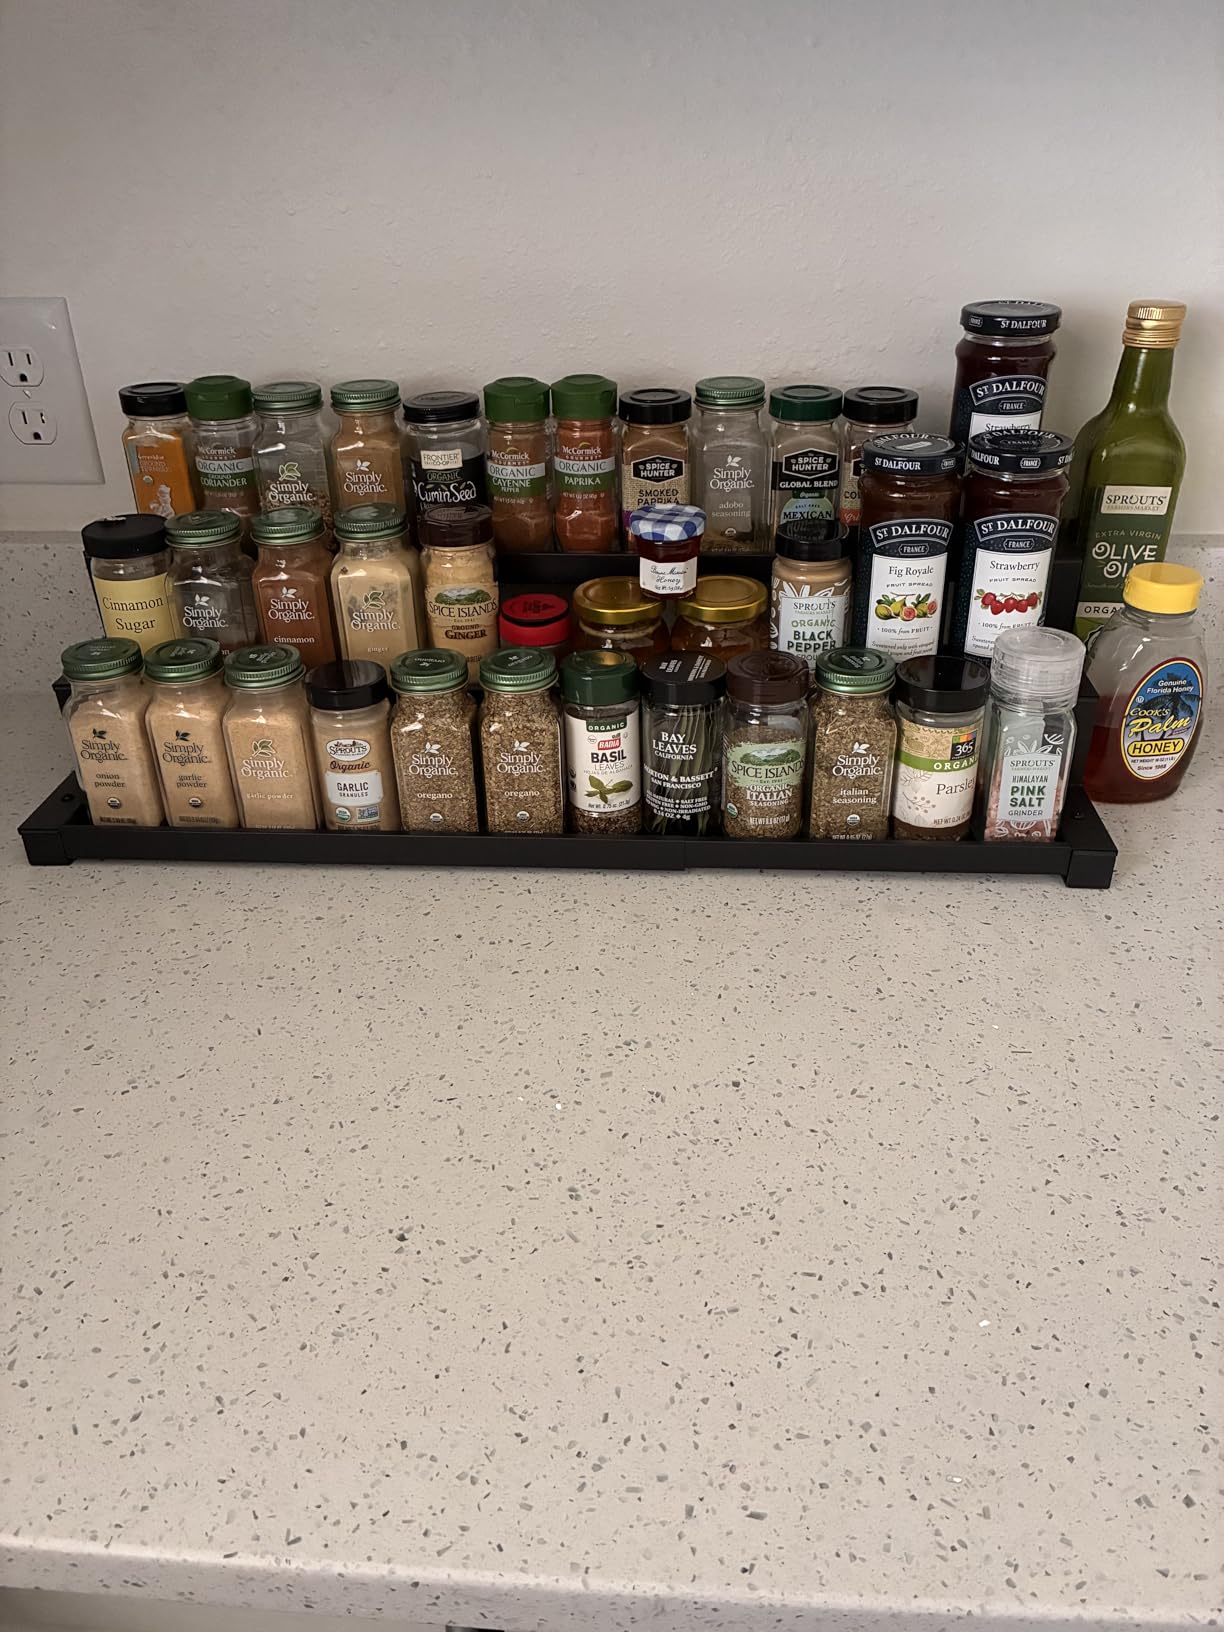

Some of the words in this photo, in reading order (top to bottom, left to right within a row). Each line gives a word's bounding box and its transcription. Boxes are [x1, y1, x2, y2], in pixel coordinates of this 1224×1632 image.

[1011, 320, 1047, 328] DALFOUR
[976, 386, 988, 397] ST
[992, 381, 1045, 395] DALFOUR
[492, 450, 530, 459] McCormick
[562, 445, 602, 454] McCormick
[798, 456, 824, 464] SPICE
[883, 460, 921, 470] DALFOUR
[198, 461, 244, 472] ORGANIC
[490, 465, 536, 477] ORGANIC
[559, 461, 606, 471] ORGANIC
[346, 472, 382, 485] Simply
[427, 471, 461, 480] ORGANIC
[713, 468, 751, 481] Simply
[200, 477, 247, 487] CORIANDER
[493, 478, 531, 487] CAYENNE
[565, 476, 601, 486] PAPRIKA
[270, 481, 309, 497] Simply
[418, 483, 452, 502] Cumin
[452, 481, 476, 501] Seed
[639, 489, 679, 497] SMOKED
[1106, 495, 1164, 505] SPROUTS
[711, 510, 750, 518] seasoning
[783, 511, 832, 519] MEXICAN
[890, 525, 949, 538] DALFOUR
[996, 520, 1054, 533] DALFOUR
[1096, 530, 1125, 538] EXTRA
[1130, 530, 1161, 540] VIRGIN
[1092, 542, 1158, 560] OLIVE
[889, 566, 902, 575] Fig
[905, 566, 934, 576] Royale
[990, 561, 1040, 571] Strawberry
[656, 576, 681, 585] Honey
[103, 597, 163, 611] Cinnamon
[270, 599, 309, 611] Simply
[429, 602, 455, 617] SPICE
[458, 599, 497, 617] ISLANDS
[794, 601, 835, 610] SPROUTS
[184, 606, 222, 619] Simply
[352, 610, 394, 624] Simply
[116, 618, 155, 633] Sugar
[792, 619, 836, 627] ORGANIC
[274, 636, 314, 644] cinnamon
[445, 630, 487, 639] GINGER
[794, 630, 832, 641] BLACK
[788, 640, 836, 652] PEPPER
[588, 723, 624, 731] ORGANIC
[1128, 715, 1191, 738] Palm
[661, 732, 685, 743] BAY
[82, 740, 120, 753] Simply
[164, 742, 203, 754] Simply
[329, 745, 367, 755] SPROUTS
[600, 740, 620, 749] BADIA
[652, 740, 697, 753] LEAVES
[955, 742, 974, 756] 365
[1132, 741, 1180, 753] HONEY
[412, 754, 453, 766] Simply
[501, 752, 541, 765] Simply
[591, 750, 626, 763] BASIL
[655, 751, 693, 760] CALIFORNIA
[837, 754, 880, 767] Simply
[242, 758, 284, 770] Simply
[330, 761, 370, 773] Organic
[595, 761, 624, 770] LEAVES
[732, 761, 762, 778] SPICE
[680, 771, 714, 782] BASSETT
[337, 782, 368, 791] GARLIC
[1011, 786, 1046, 796] PINK
[504, 790, 539, 798] oregano
[746, 788, 792, 801] ITALIAN
[832, 796, 877, 804] seasoning
[1009, 798, 1045, 808] SALT
[664, 805, 711, 814] NON-IRRADIATED
